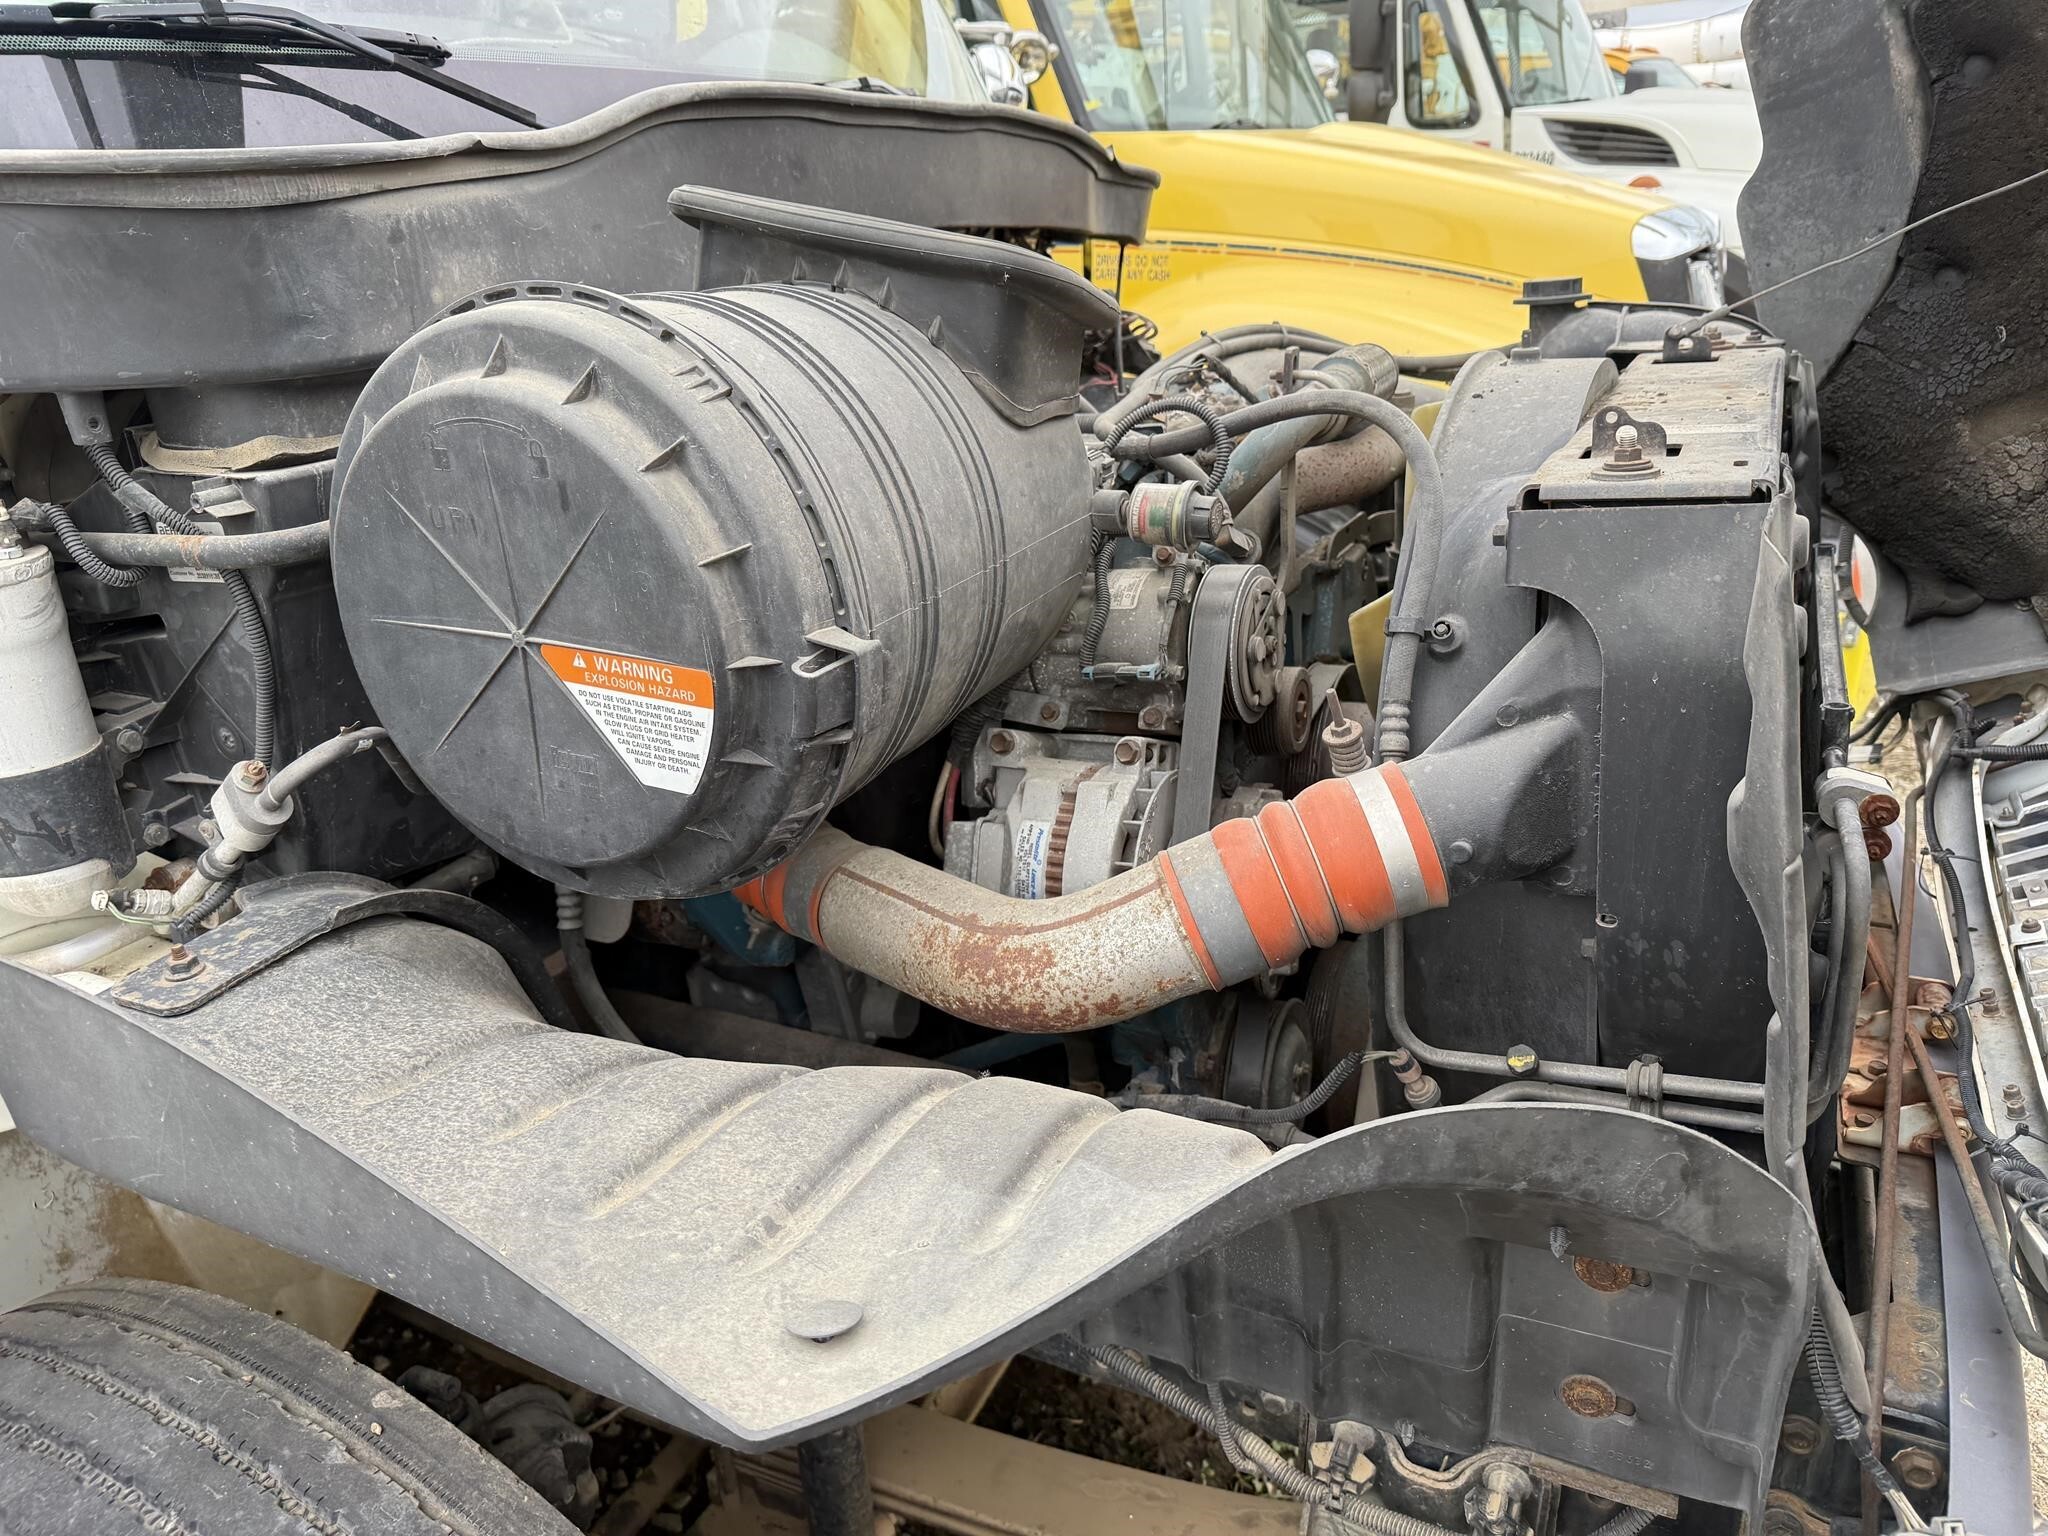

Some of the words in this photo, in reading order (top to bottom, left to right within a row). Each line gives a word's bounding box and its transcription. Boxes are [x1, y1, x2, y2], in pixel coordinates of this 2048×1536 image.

[1135, 255, 1148, 268] DO
[1152, 255, 1169, 268] NOT
[1127, 269, 1144, 281] ANY
[1148, 269, 1171, 282] CASH
[593, 654, 673, 684] WARNING
[584, 670, 645, 693] EXPLOSION
[648, 683, 696, 702] HAZARD
[578, 688, 587, 697] DO
[588, 691, 600, 700] NOT
[602, 693, 614, 702] USE
[615, 696, 643, 708] VOLATILE
[644, 702, 675, 715] STARTING
[677, 708, 692, 718] AIDS
[584, 698, 601, 708] SUCH
[602, 701, 611, 710] AS
[634, 708, 662, 720] PROPANE
[663, 713, 673, 722] OR
[674, 715, 705, 729] GASOLINE
[595, 708, 601, 716] IN
[602, 710, 614, 719] THE
[615, 712, 637, 723] ENGINE
[638, 716, 649, 725] AIR
[649, 719, 672, 730] INTAKE
[673, 723, 701, 736] SYSTEM.
[603, 718, 621, 728] GLOW
[623, 722, 642, 732] PLUGS
[643, 726, 652, 734] OR
[653, 728, 668, 738] GRID
[670, 731, 695, 743] HEATER
[610, 728, 624, 737] WILL
[625, 731, 645, 741] IGNITE
[646, 735, 673, 747] VAPORS.
[617, 737, 630, 746] CAN
[631, 740, 651, 750] CAUSE
[652, 744, 676, 755] SEVERE
[677, 749, 700, 760] ENGINE
[625, 747, 652, 758] DAMAGE
[653, 752, 667, 761] AND
[667, 755, 700, 768] PERSONAL
[634, 757, 655, 767] INJURY
[657, 761, 666, 770] OR
